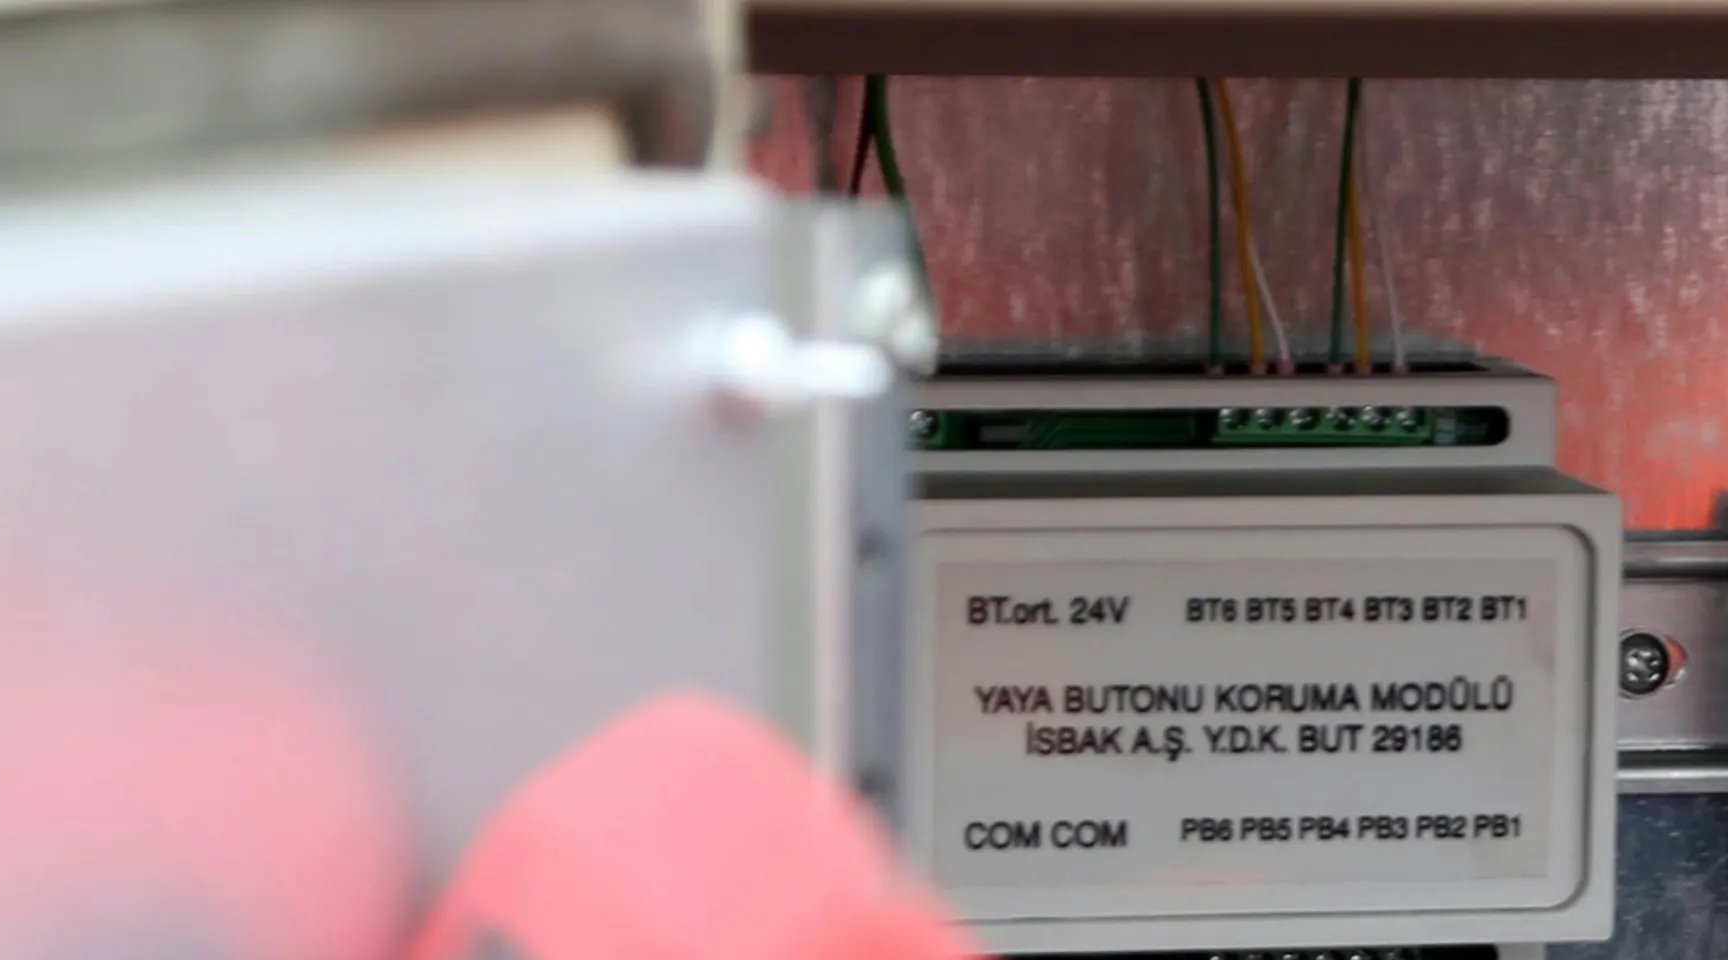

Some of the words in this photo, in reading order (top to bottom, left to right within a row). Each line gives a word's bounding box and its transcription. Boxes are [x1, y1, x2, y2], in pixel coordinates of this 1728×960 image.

[1068, 595, 1131, 625] 24V
[1185, 598, 1237, 623] BT6
[1245, 597, 1296, 623] BT5
[1304, 597, 1356, 622] BT4
[1363, 596, 1414, 622] BT3
[1422, 596, 1473, 621] BT2
[1480, 595, 1527, 621] BT1
[974, 684, 1054, 715] YAYA
[1063, 683, 1206, 714] BUTONU
[1214, 682, 1361, 713] KORUMA
[1370, 674, 1514, 713] MODÜLÜ
[1026, 721, 1126, 756] İSBAK
[1129, 725, 1193, 763] A.Ş.
[1298, 723, 1365, 753] BUT
[1371, 723, 1463, 753] 29186
[964, 820, 1042, 850] COM
[1050, 820, 1129, 850] COM
[1180, 817, 1234, 843] PB6
[1239, 817, 1293, 842] PB5
[1298, 817, 1351, 841] PB4
[1357, 816, 1409, 841] PB3
[1415, 815, 1467, 840] PB2
[1472, 814, 1521, 839] PB1
